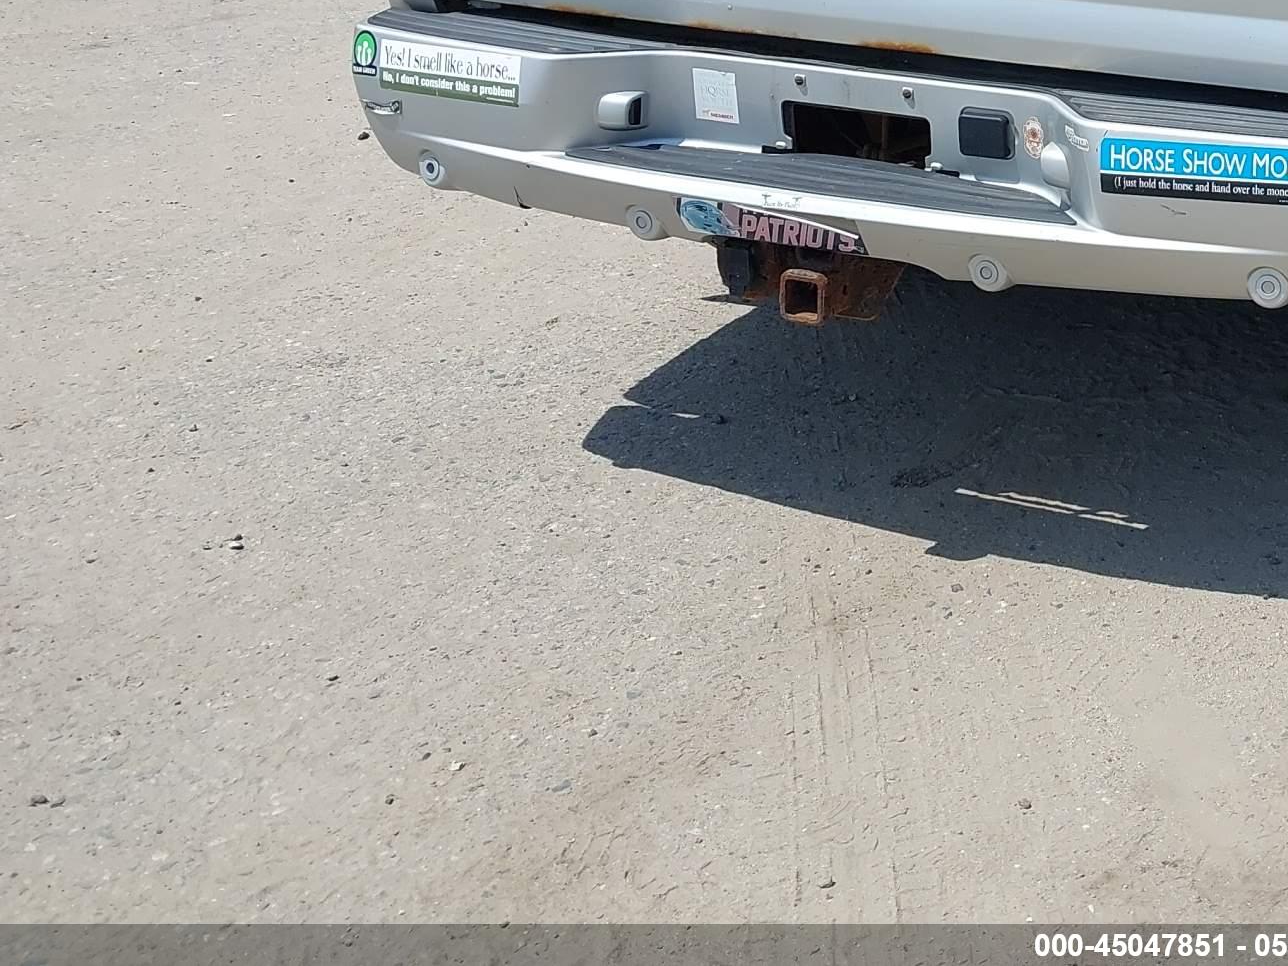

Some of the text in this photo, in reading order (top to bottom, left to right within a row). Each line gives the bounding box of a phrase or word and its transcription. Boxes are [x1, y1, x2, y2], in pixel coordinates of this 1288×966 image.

[385, 45, 405, 67] Yes!
[407, 48, 412, 68] I
[413, 51, 443, 72] smell
[444, 52, 464, 74] like
[466, 61, 473, 75] a
[383, 71, 516, 98] No, I don't consider this a problem!
[1110, 144, 1175, 172] HORSE
[1182, 148, 1247, 176] SHOW
[1114, 176, 1122, 189] (I
[1122, 177, 1137, 190] just
[1139, 177, 1157, 189] hold
[1158, 178, 1171, 190] the
[1172, 179, 1194, 191] horse
[1195, 181, 1210, 192] and
[1211, 181, 1231, 194] hand
[1232, 185, 1250, 195] over
[1252, 184, 1265, 195] the
[741, 214, 856, 252] PATRIOTS
